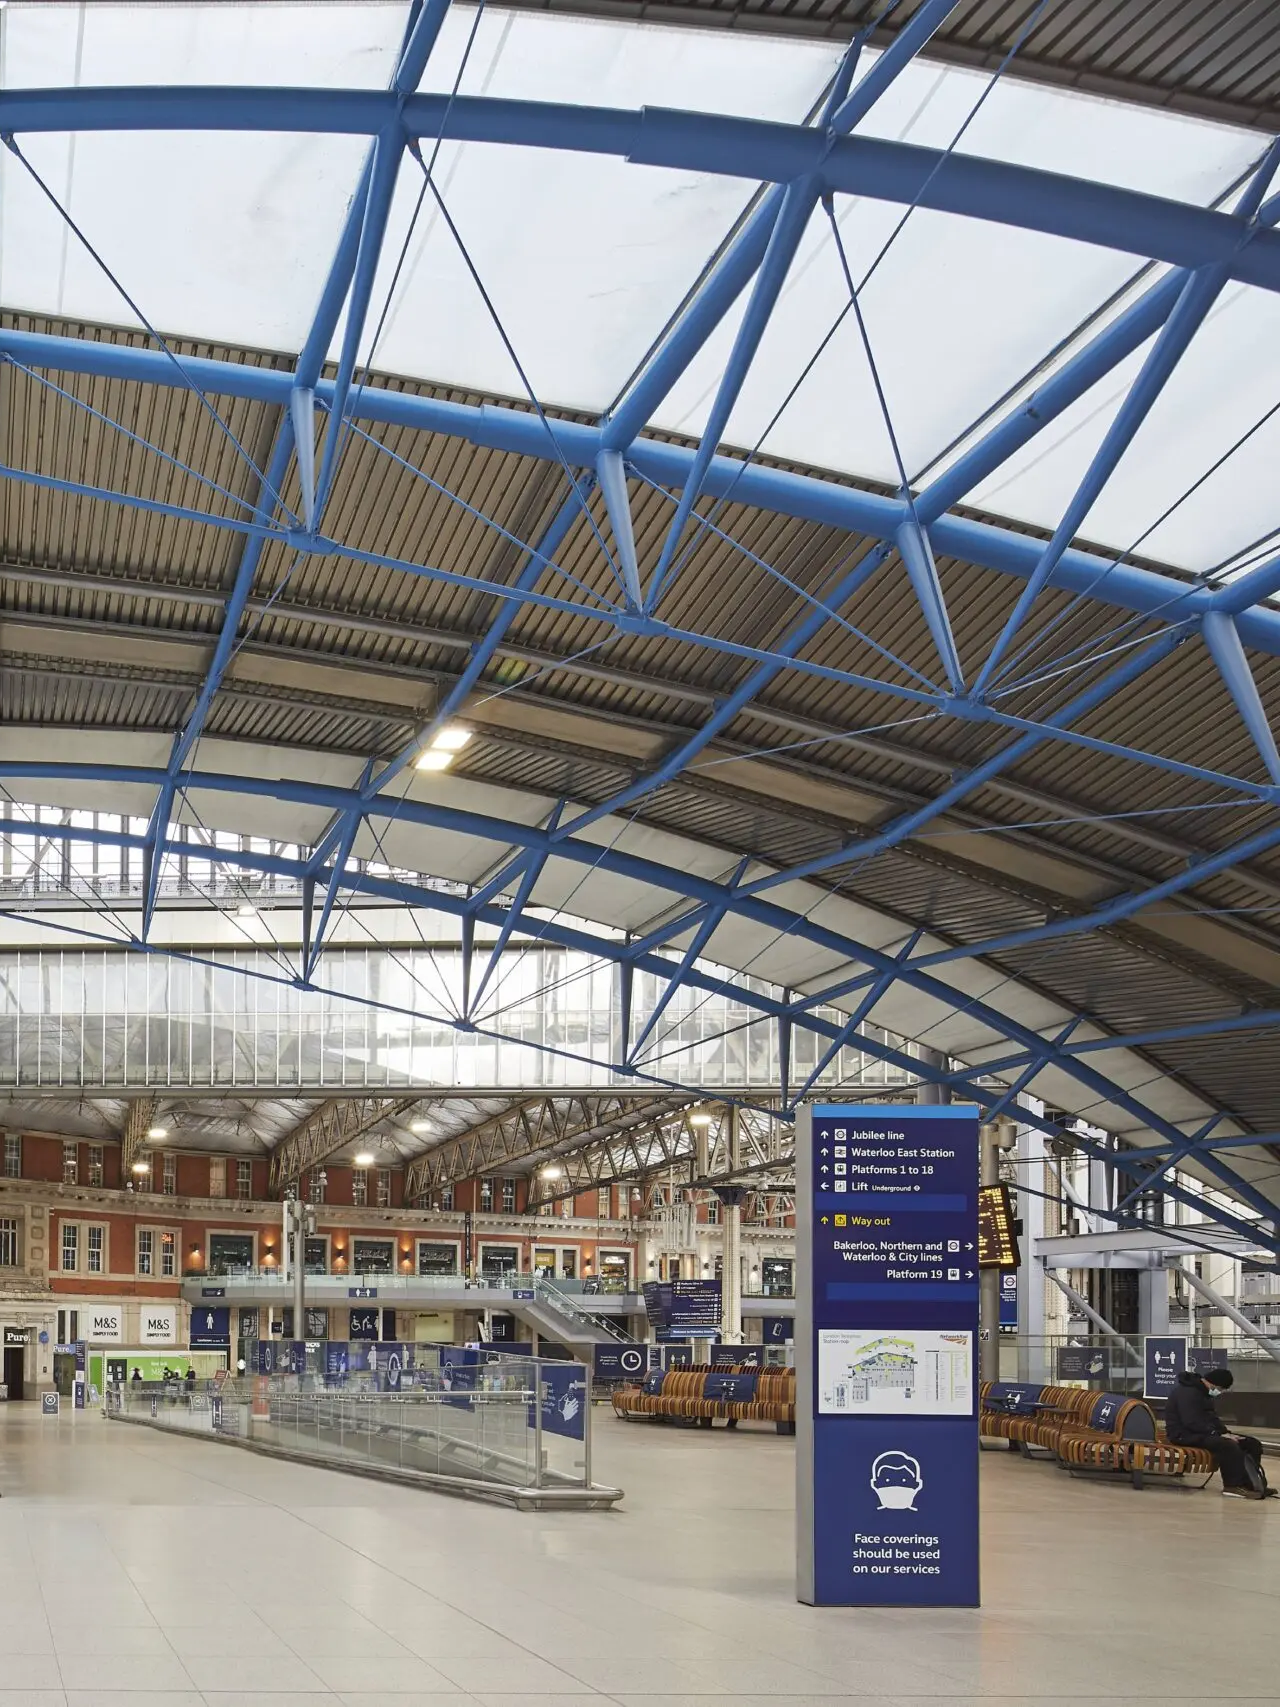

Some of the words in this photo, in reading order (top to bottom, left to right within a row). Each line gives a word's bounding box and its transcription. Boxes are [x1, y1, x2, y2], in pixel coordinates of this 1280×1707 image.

[851, 1130, 886, 1140] Jubilee
[887, 1130, 905, 1140] line
[851, 1148, 895, 1158] Waterloo
[897, 1148, 917, 1158] East
[920, 1147, 955, 1158] Station
[851, 1164, 898, 1174] Platforms
[900, 1165, 906, 1174] 1
[908, 1166, 919, 1174] to
[922, 1165, 934, 1174] 18
[851, 1182, 868, 1191] Lift
[851, 1216, 872, 1227] Way
[874, 1217, 891, 1226] out
[833, 1240, 878, 1251] Bakerloo,
[880, 1241, 923, 1251] Northern
[924, 1241, 943, 1251] and
[842, 1252, 887, 1262] Waterloo
[888, 1252, 897, 1262] &
[898, 1252, 918, 1263] City
[920, 1253, 943, 1262] lines
[886, 1269, 928, 1279] Platform
[931, 1270, 943, 1279] 19
[94, 1317, 118, 1329] M&S
[148, 1319, 170, 1330] M&S
[6, 1332, 31, 1342] Pure.
[854, 1533, 881, 1544] Face
[883, 1534, 939, 1547] coverings
[852, 1548, 893, 1559] should
[895, 1549, 910, 1559] be
[912, 1549, 941, 1559] used
[852, 1565, 868, 1574] on
[870, 1565, 891, 1574] our
[893, 1564, 941, 1574] services
